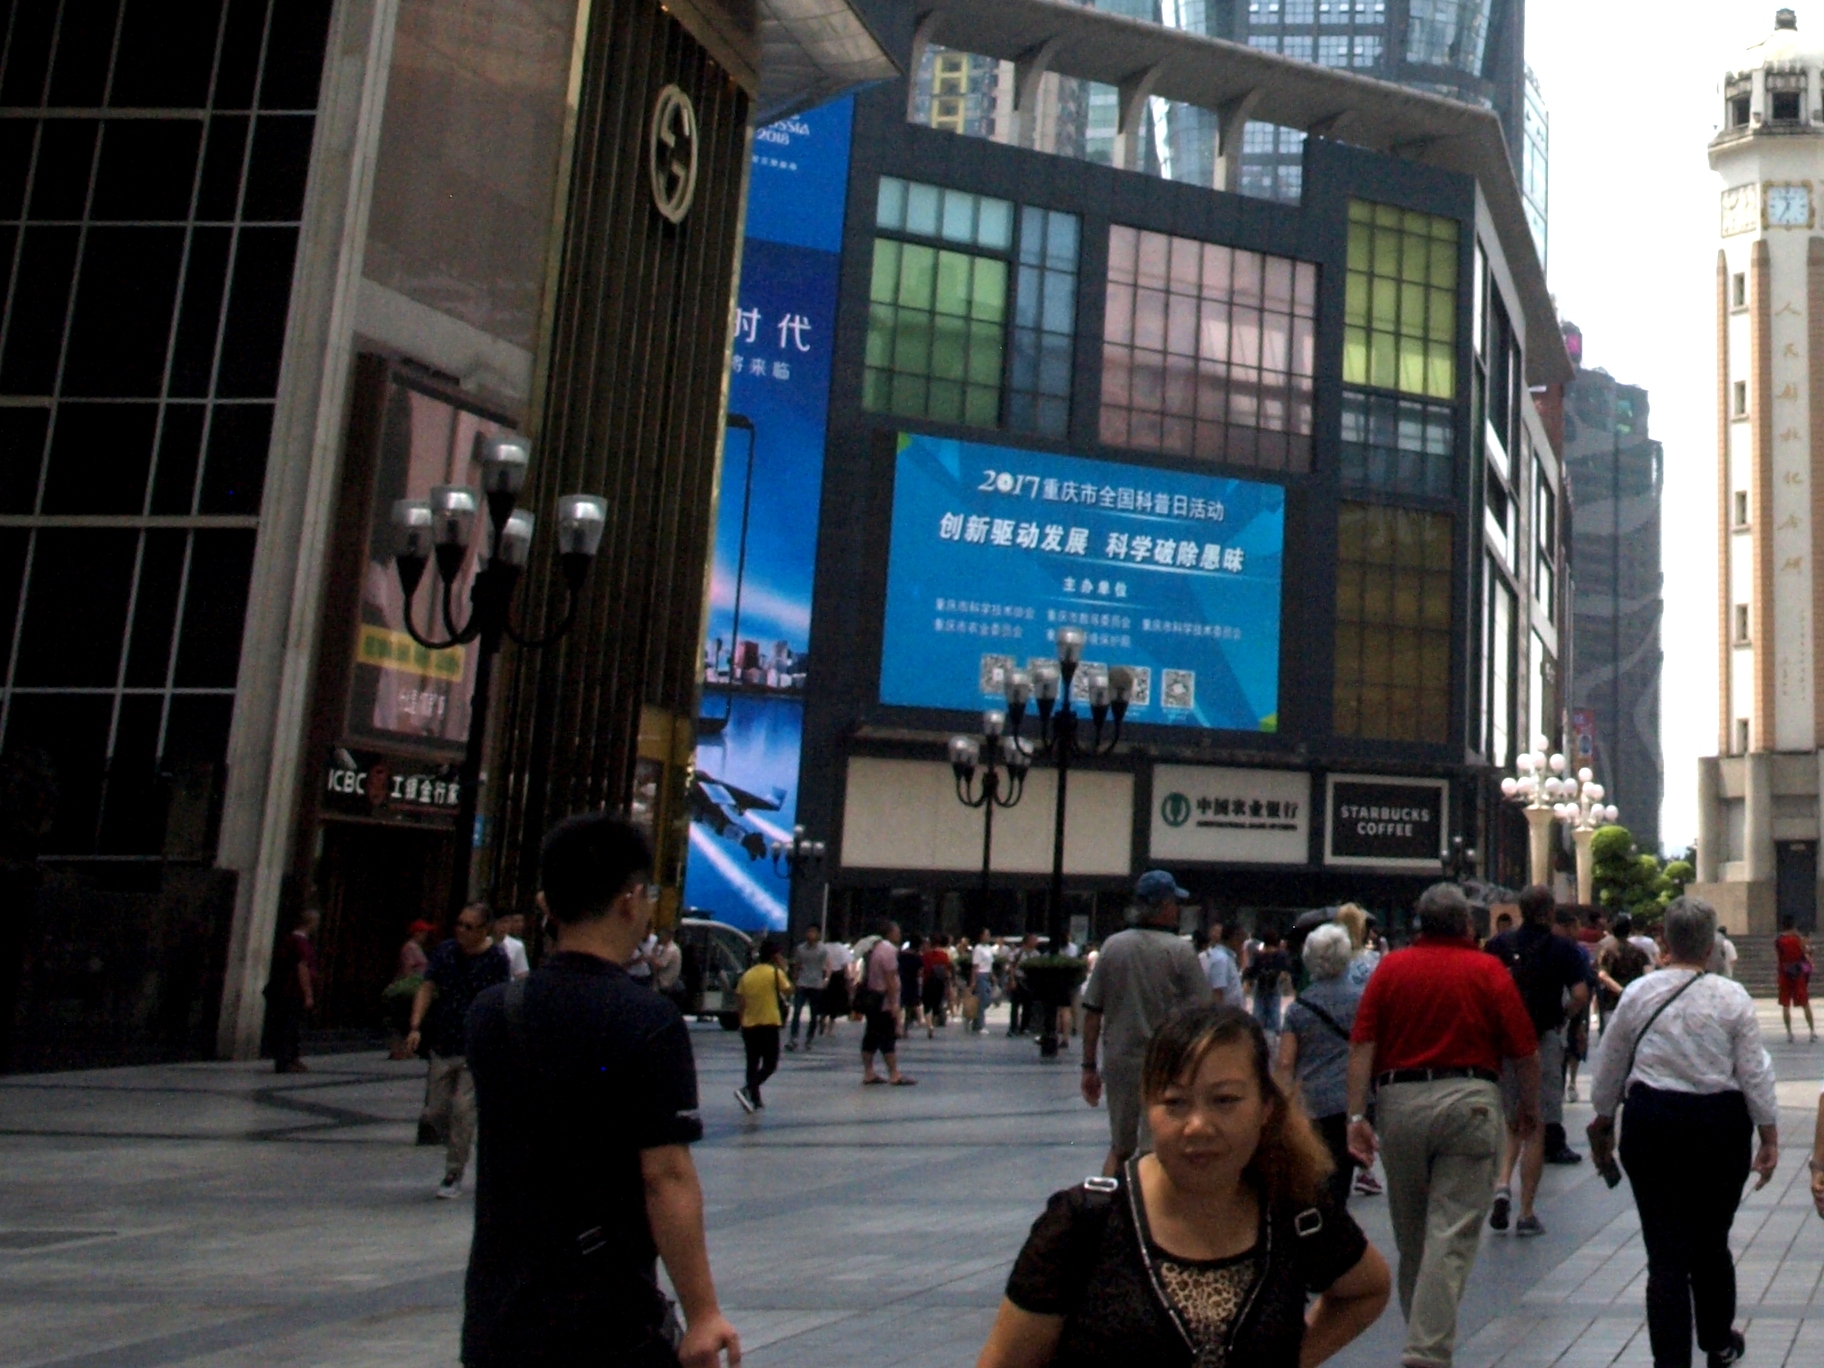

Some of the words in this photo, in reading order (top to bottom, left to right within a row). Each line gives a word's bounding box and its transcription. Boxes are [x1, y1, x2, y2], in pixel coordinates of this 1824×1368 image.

[756, 128, 790, 145] 2018
[734, 307, 812, 352] 时代
[938, 511, 1090, 556] 创新驱动发展
[1105, 531, 1246, 574] 科学破除愚昧
[1062, 576, 1128, 598] 主办单位
[327, 768, 367, 795] ICBC
[1196, 796, 1299, 820] 中国农业银行
[1340, 804, 1430, 822] STARBUCKS
[1356, 821, 1413, 837] COFFEE
